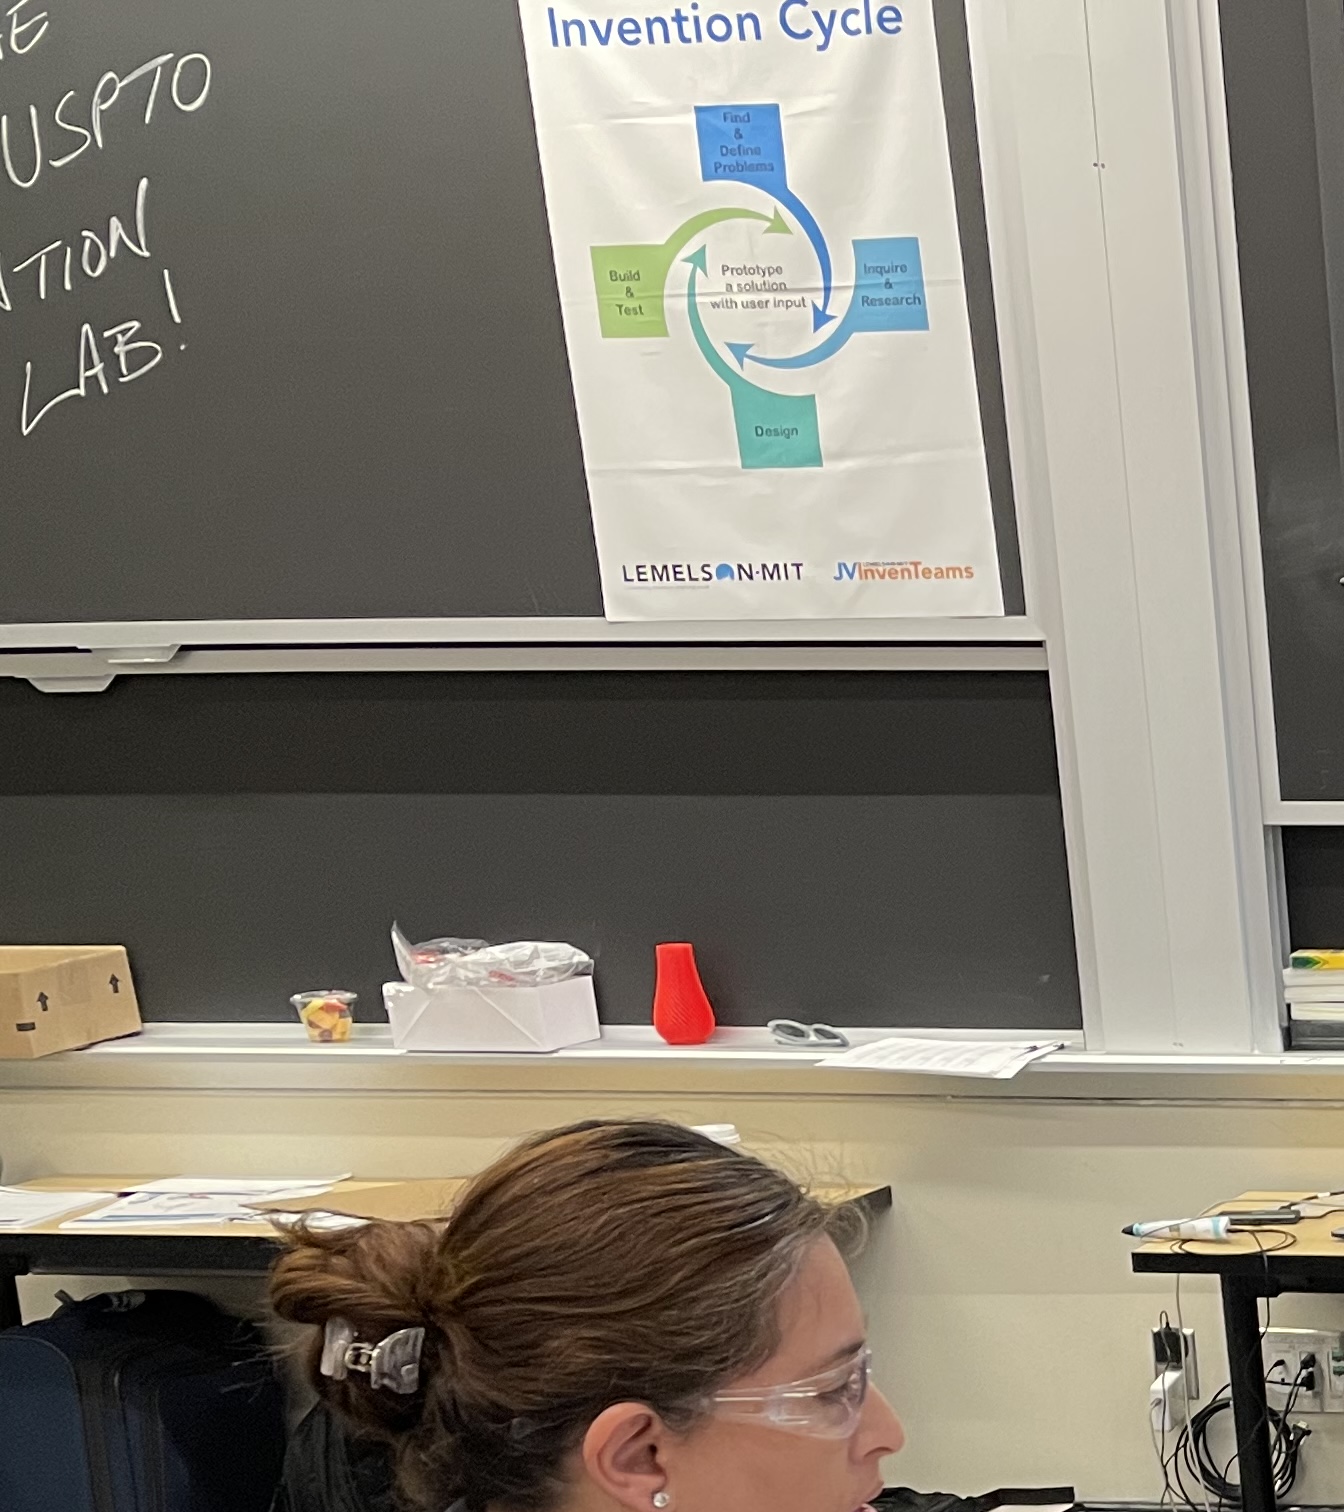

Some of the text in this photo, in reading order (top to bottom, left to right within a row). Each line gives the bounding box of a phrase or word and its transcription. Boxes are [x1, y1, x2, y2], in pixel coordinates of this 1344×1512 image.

[547, 0, 903, 52] Invention Cycle
[2, 52, 211, 188] USPTO
[722, 111, 751, 124] Find
[733, 128, 743, 140] &
[719, 144, 761, 158] Define
[713, 160, 775, 174] Problems
[720, 264, 784, 279] Prototype
[862, 262, 908, 276] Inquire
[609, 270, 641, 283] Build
[884, 278, 894, 289] &
[625, 286, 635, 298] &
[725, 280, 788, 293] a solution
[710, 297, 807, 311] with user input
[861, 294, 922, 308] Research
[615, 303, 644, 317] Test
[21, 269, 187, 437] LAB!
[754, 424, 799, 440] Design
